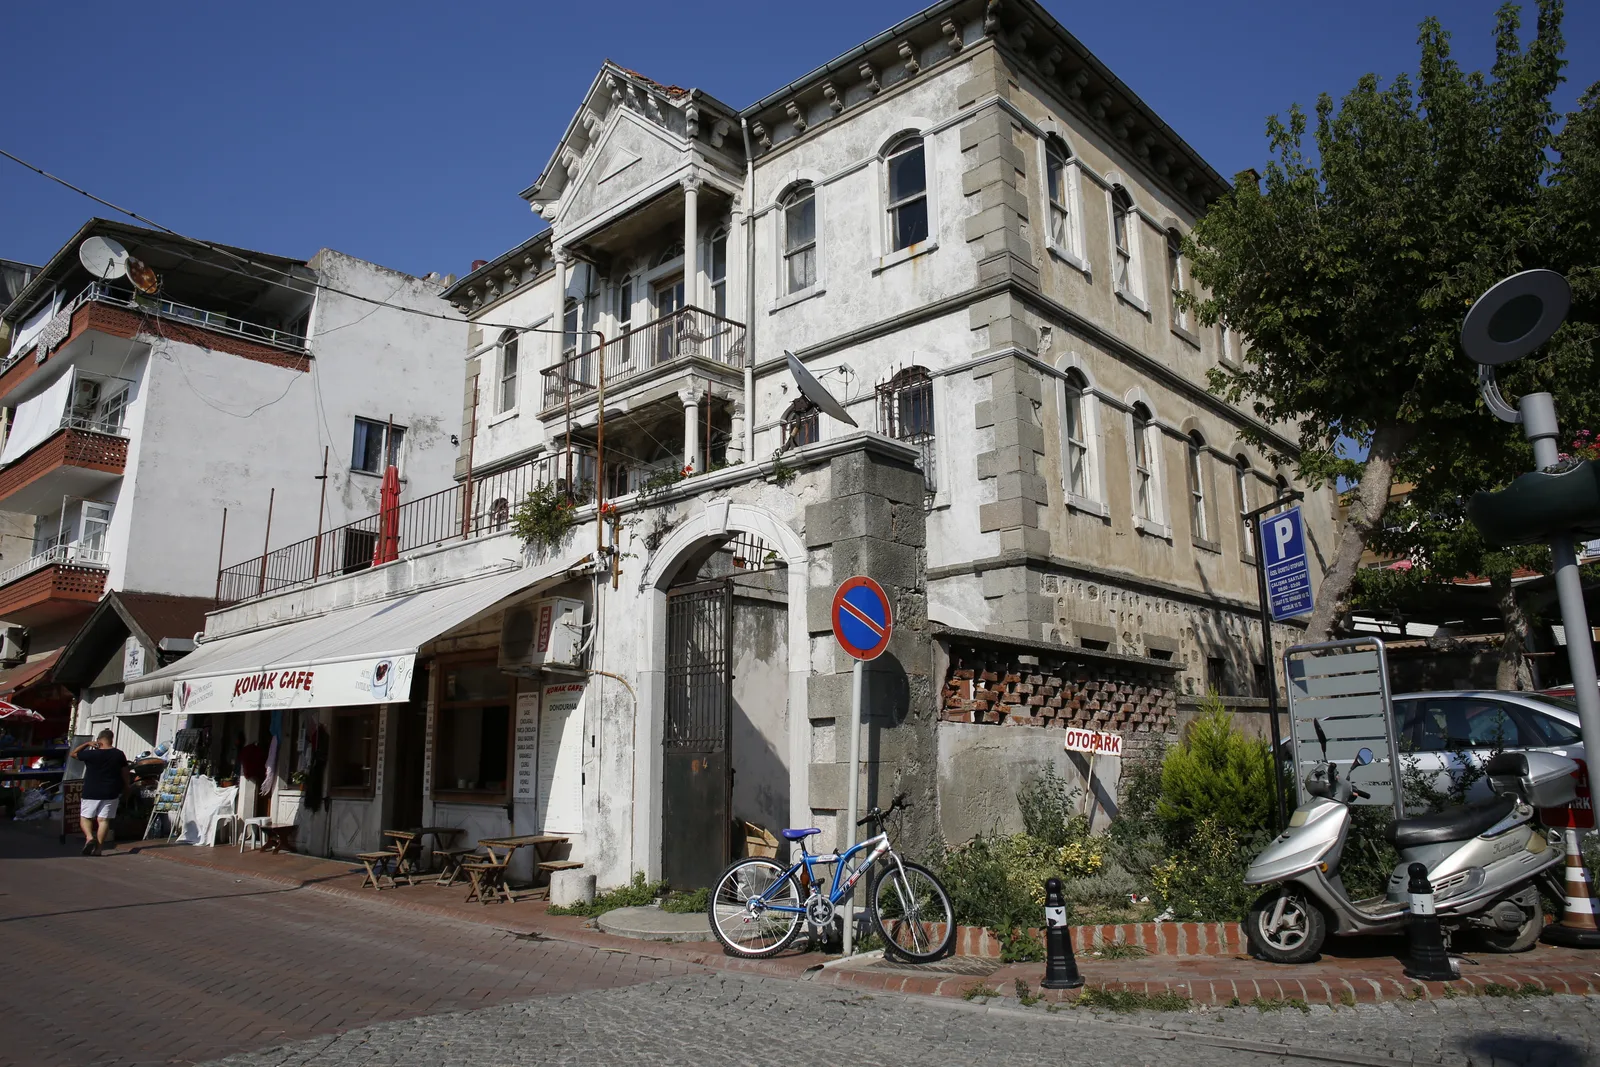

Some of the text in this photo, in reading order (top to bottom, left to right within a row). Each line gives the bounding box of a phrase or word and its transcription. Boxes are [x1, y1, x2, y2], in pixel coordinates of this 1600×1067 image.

[1274, 518, 1293, 559] P
[539, 609, 549, 651] VESTEL
[233, 672, 278, 697] KONAK
[279, 671, 314, 691] CAFE
[549, 703, 577, 711] DONDURMA
[1067, 731, 1120, 753] OTOPARK
